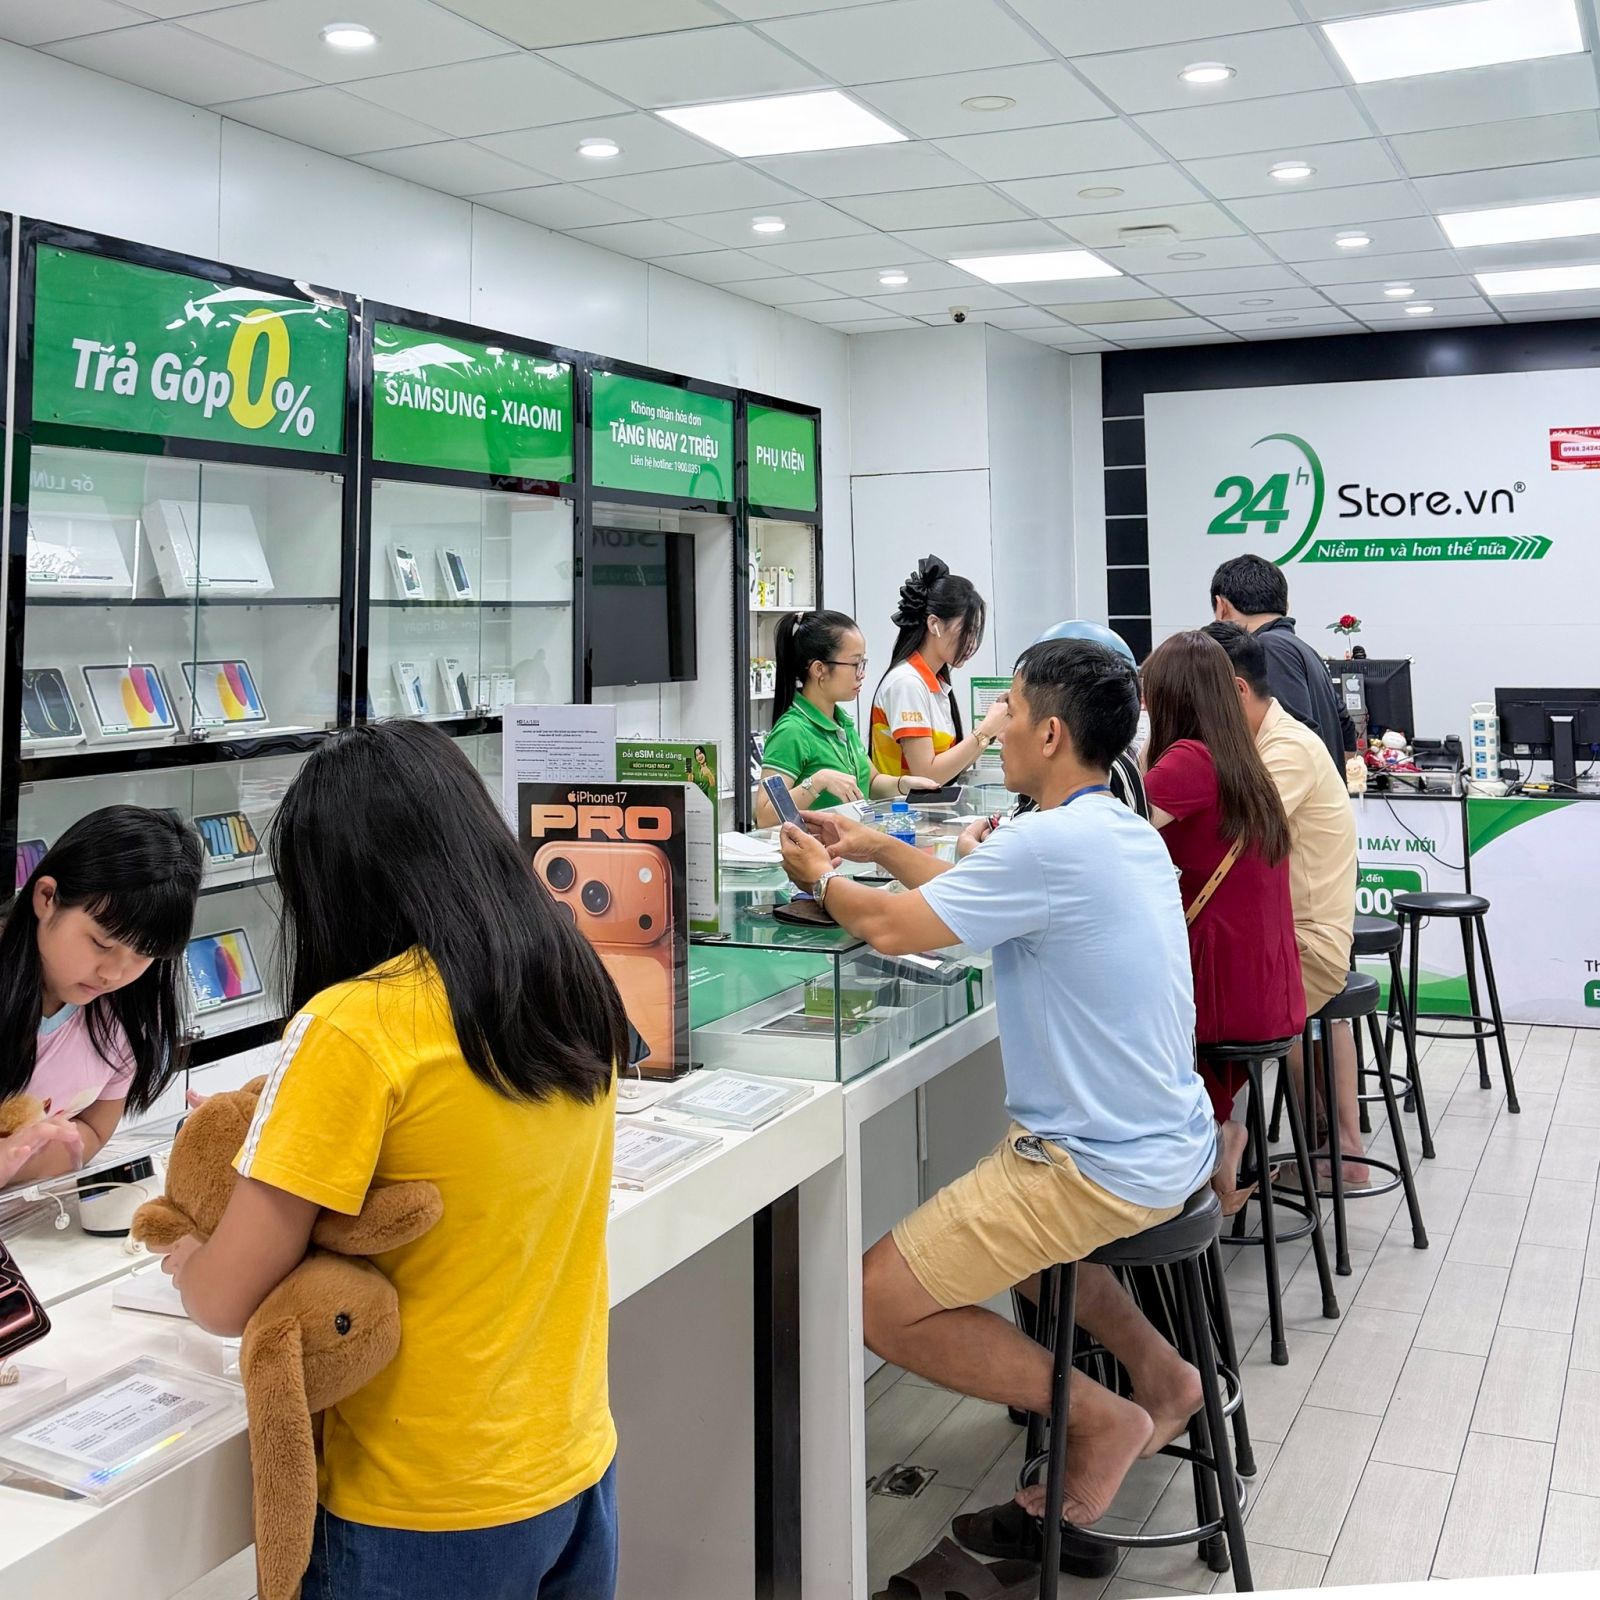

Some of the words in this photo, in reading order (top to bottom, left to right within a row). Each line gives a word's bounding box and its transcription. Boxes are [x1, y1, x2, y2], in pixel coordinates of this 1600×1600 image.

[71, 338, 139, 396] Trả
[151, 352, 230, 418] Góp
[385, 379, 487, 420] SAMSUNG
[501, 400, 562, 432] XIAOMI
[631, 400, 656, 420] Không
[656, 406, 674, 423] nhận
[675, 408, 688, 424] hóa
[688, 413, 702, 426] đơn
[609, 418, 645, 448] TẶNG
[647, 427, 678, 452] NGAY
[680, 434, 688, 453] 2
[688, 434, 719, 462] TRIỆU
[631, 454, 644, 466] Liên
[644, 456, 653, 470] hệ
[756, 445, 779, 472] PHỤ
[781, 447, 805, 475] KIỆN
[1318, 541, 1359, 558] Niềm
[1364, 544, 1385, 557] tin
[1390, 543, 1407, 557] và
[1412, 543, 1442, 557] hơn
[1447, 539, 1477, 557] thế
[1477, 542, 1507, 556] nữa
[634, 749, 655, 759] eSIM
[577, 791, 615, 804] iPhone
[615, 791, 628, 804] 17
[531, 804, 673, 841] PRO
[1367, 836, 1401, 851] MÁY
[1406, 837, 1436, 853] MỚI
[1366, 873, 1384, 883] đến
